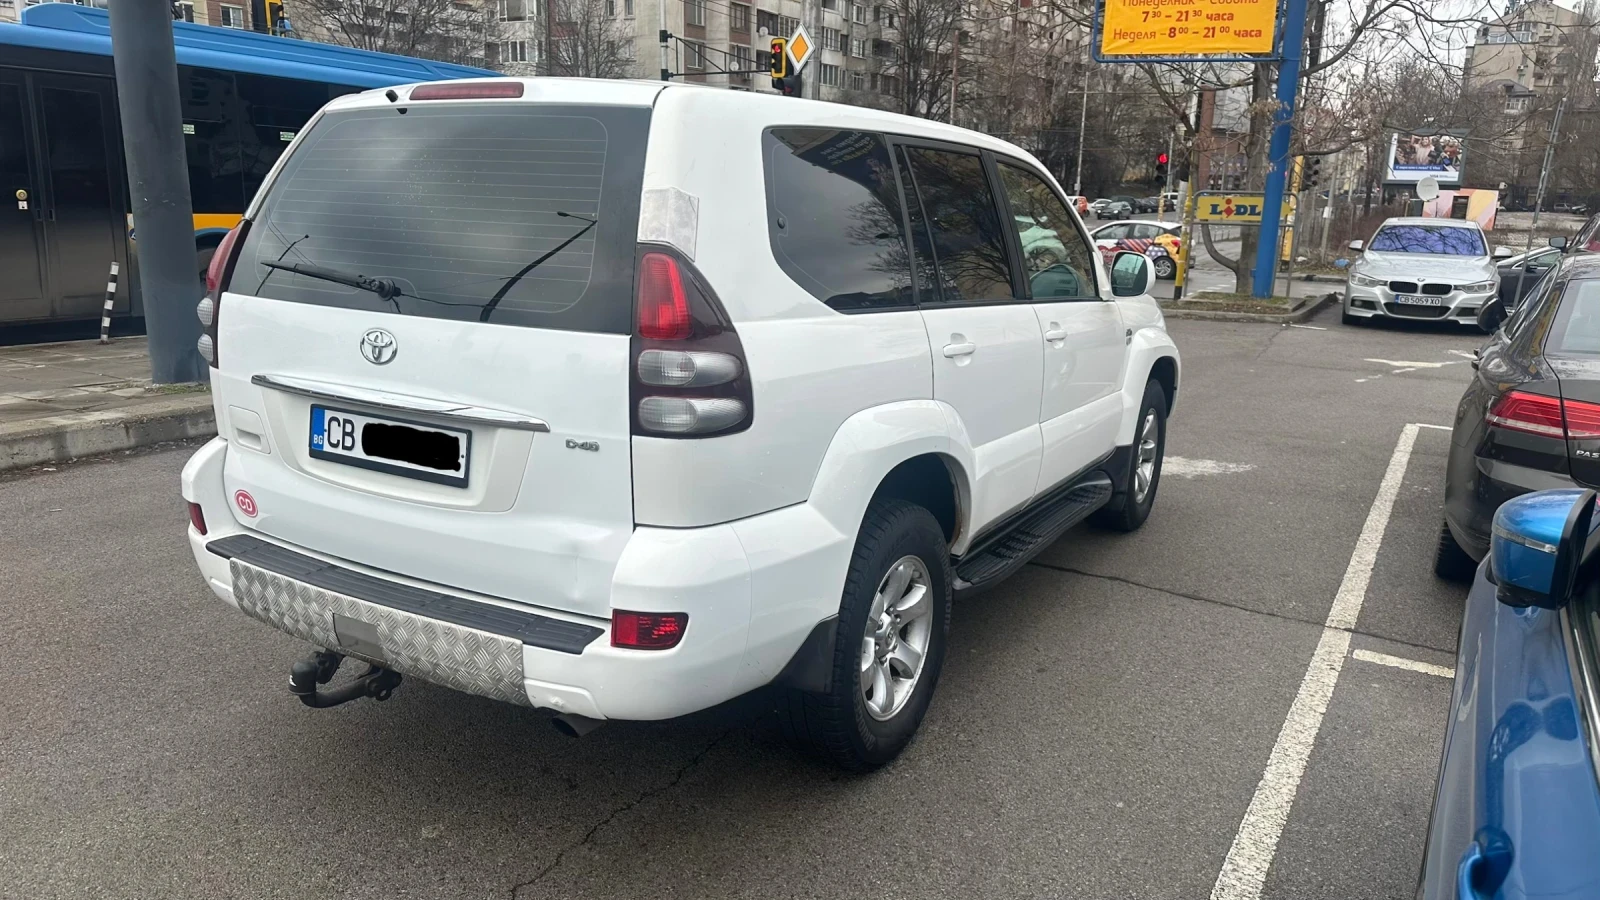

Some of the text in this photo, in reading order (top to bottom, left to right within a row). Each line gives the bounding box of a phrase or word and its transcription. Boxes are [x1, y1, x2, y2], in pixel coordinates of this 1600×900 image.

[1123, 0, 1195, 9] Понеделник
[1206, 12, 1235, 21] часа
[1113, 28, 1156, 43] Неделя
[1234, 29, 1263, 38] часа
[313, 416, 356, 451] BG CB
[238, 496, 253, 511] CD
